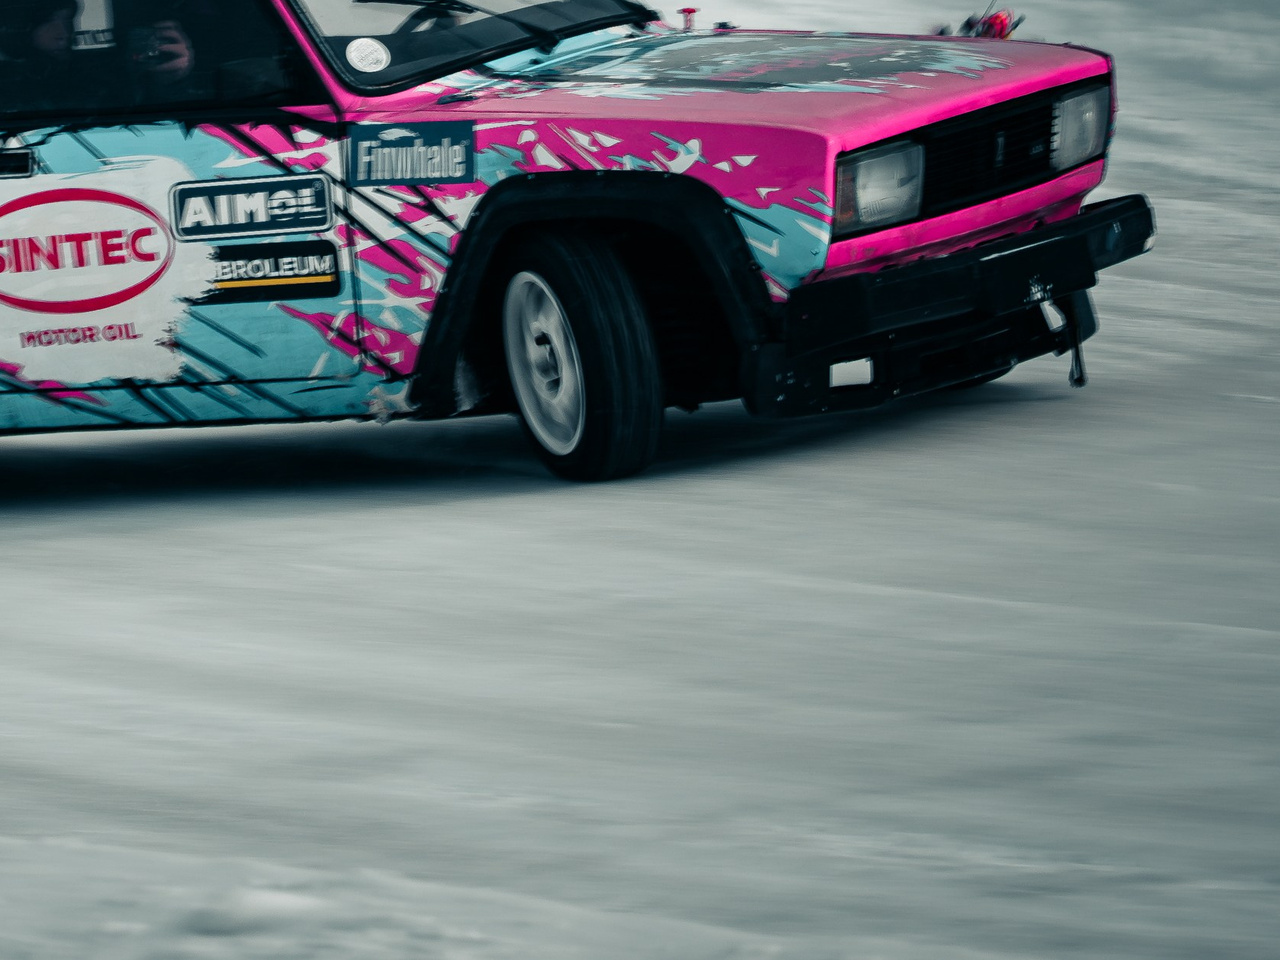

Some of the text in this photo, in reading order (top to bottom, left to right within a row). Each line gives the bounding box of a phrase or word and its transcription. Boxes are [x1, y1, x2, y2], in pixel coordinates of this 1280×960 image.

[356, 137, 467, 181] Finwhale
[179, 188, 326, 229] AIMOL
[19, 321, 143, 348] MOTOR OIL
